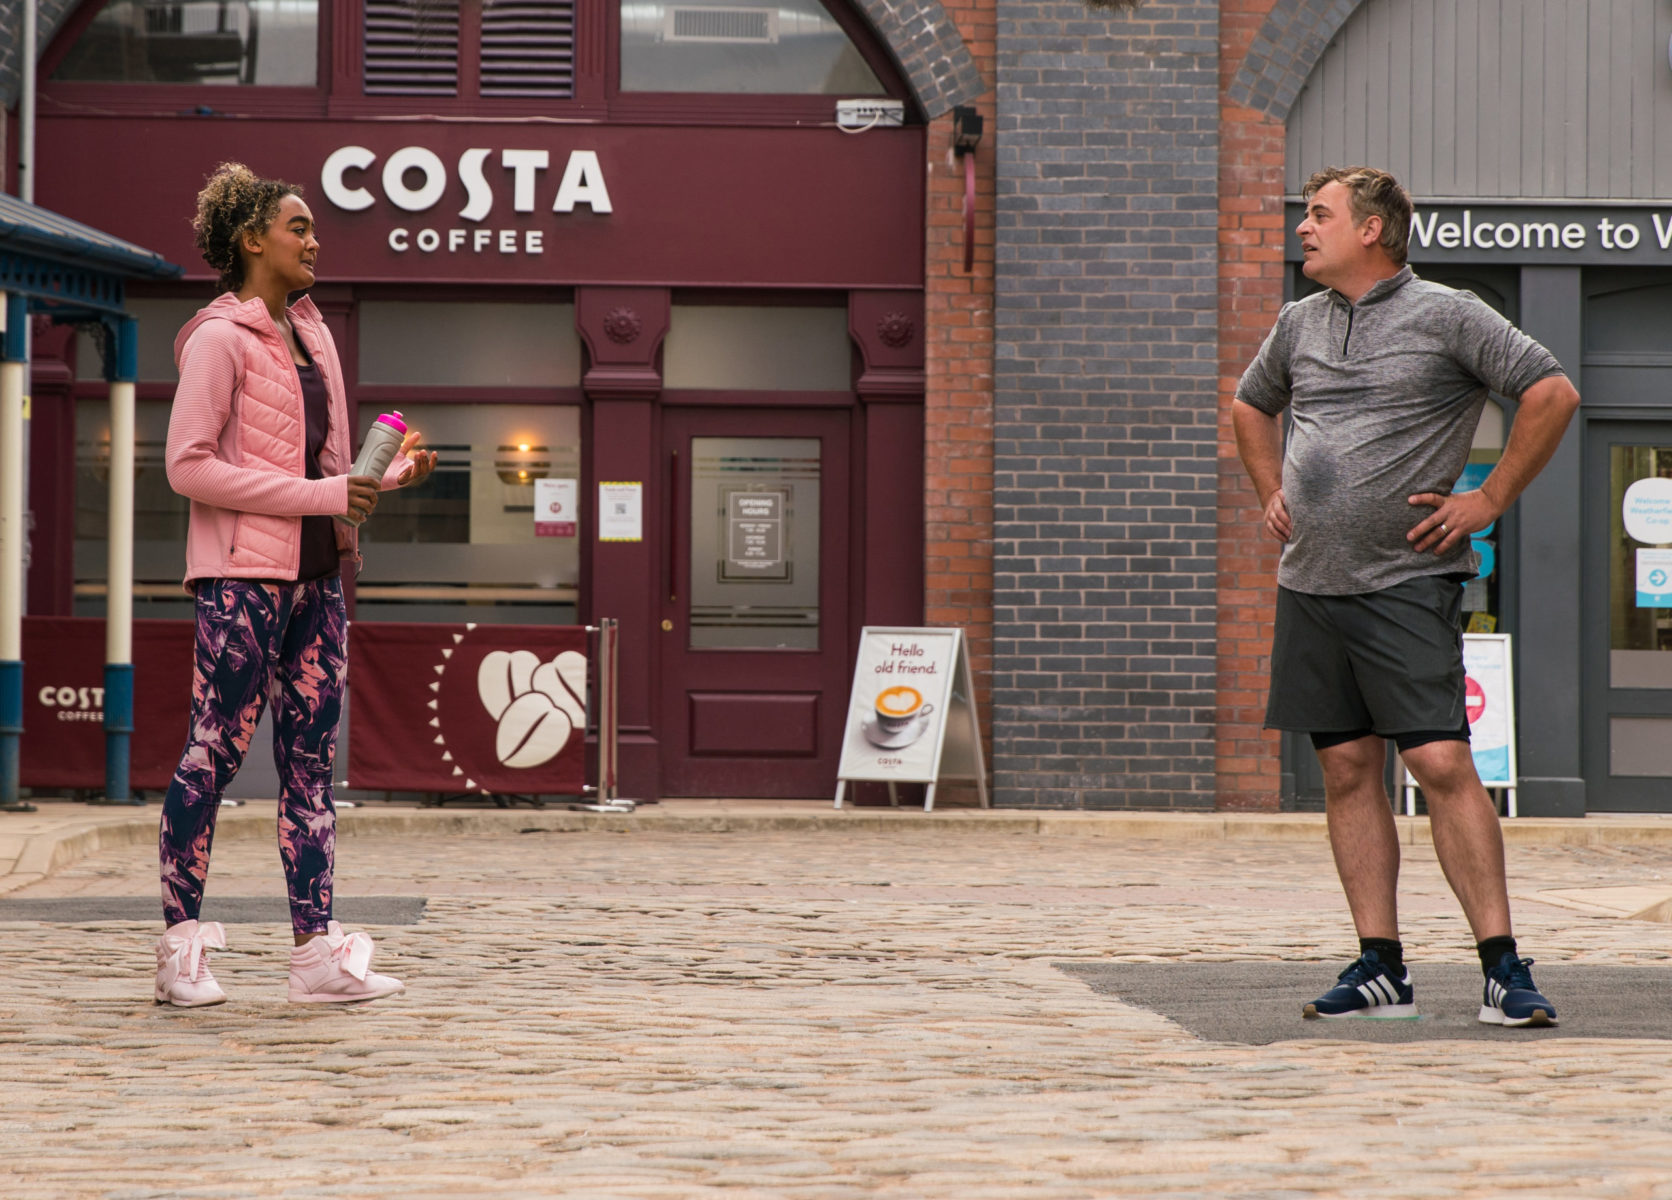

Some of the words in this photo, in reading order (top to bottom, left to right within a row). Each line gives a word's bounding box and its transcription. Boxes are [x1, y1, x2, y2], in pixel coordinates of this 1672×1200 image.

[321, 146, 613, 222] COSTA
[388, 228, 543, 253] COFFEE
[1408, 210, 1586, 249] Welcome
[1598, 218, 1640, 249] to
[891, 643, 924, 657] Hello
[874, 660, 894, 674] old
[897, 660, 937, 674] friend.
[39, 686, 105, 710] COST
[57, 711, 104, 722] COFFEE
